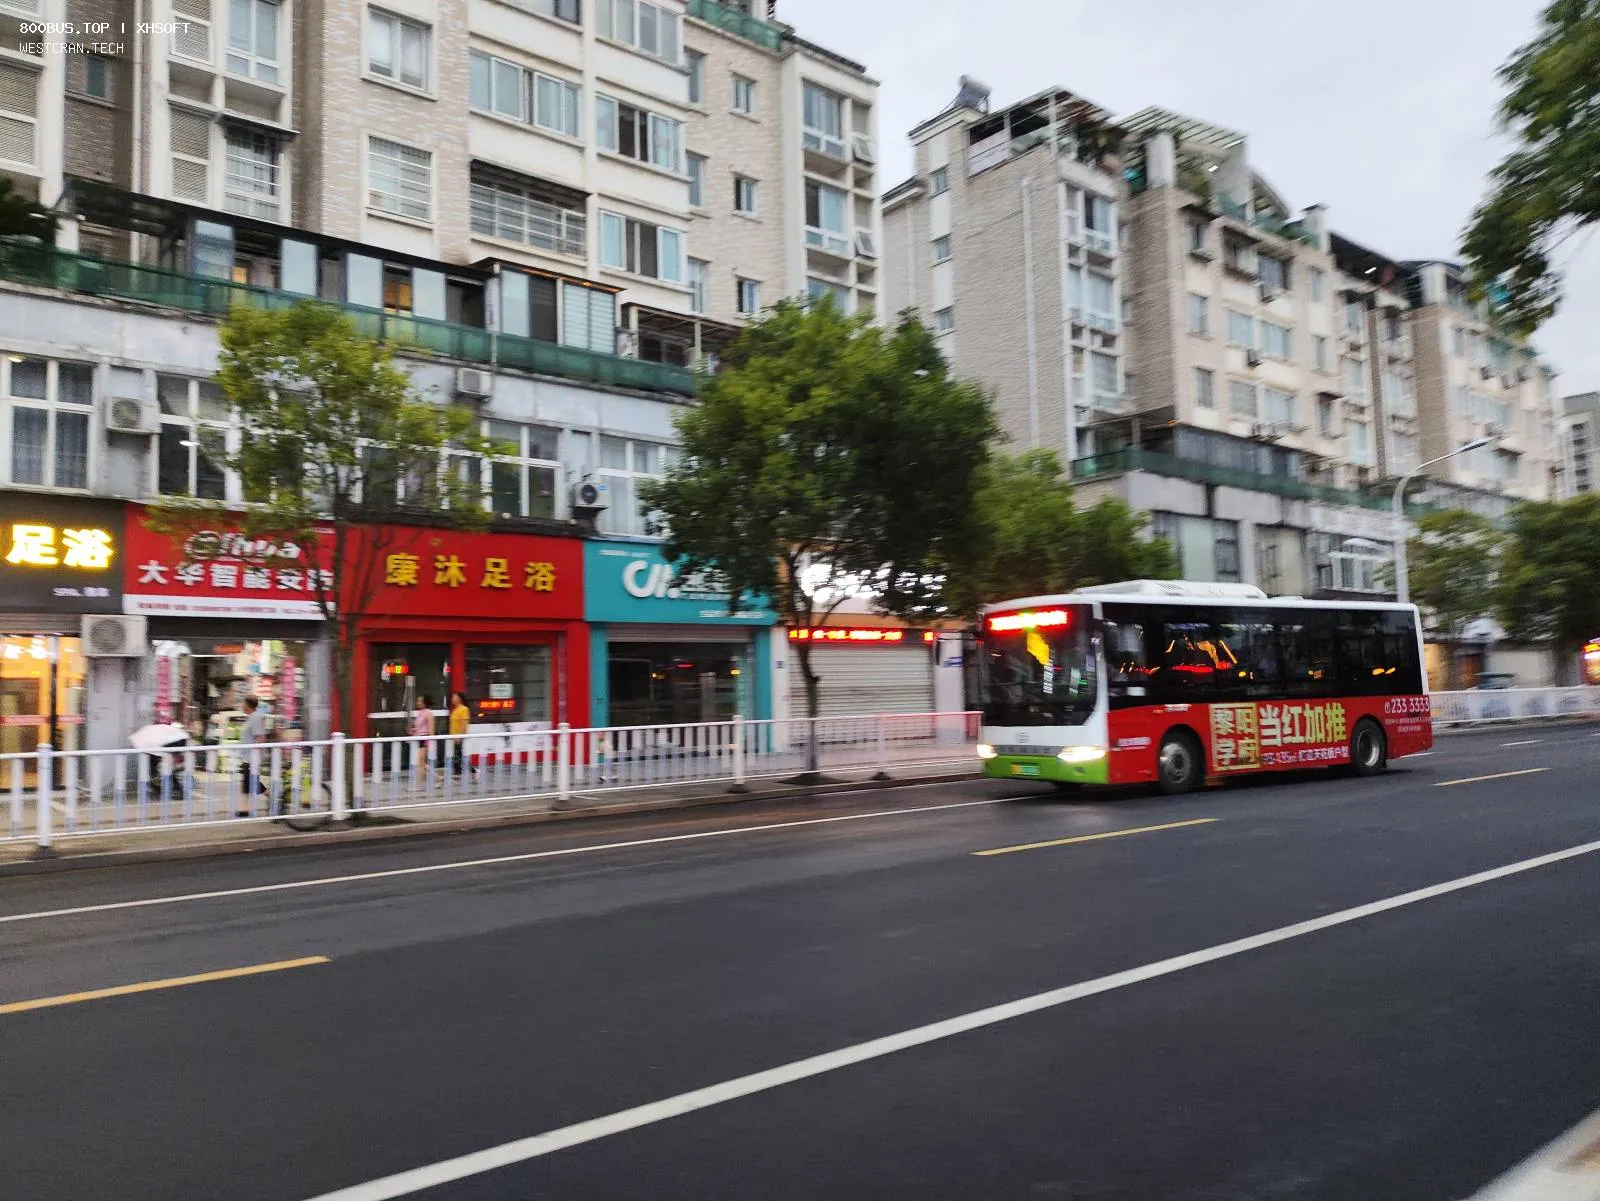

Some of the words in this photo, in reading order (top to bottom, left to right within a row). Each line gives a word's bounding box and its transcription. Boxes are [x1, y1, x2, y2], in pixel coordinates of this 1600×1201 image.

[5, 524, 114, 569] 足浴
[138, 559, 334, 592] 大华智能安防
[384, 553, 557, 592] 康沐足浴
[1259, 702, 1347, 746] 当红加推
[1391, 698, 1408, 714] 233
[1409, 697, 1430, 713] 3333
